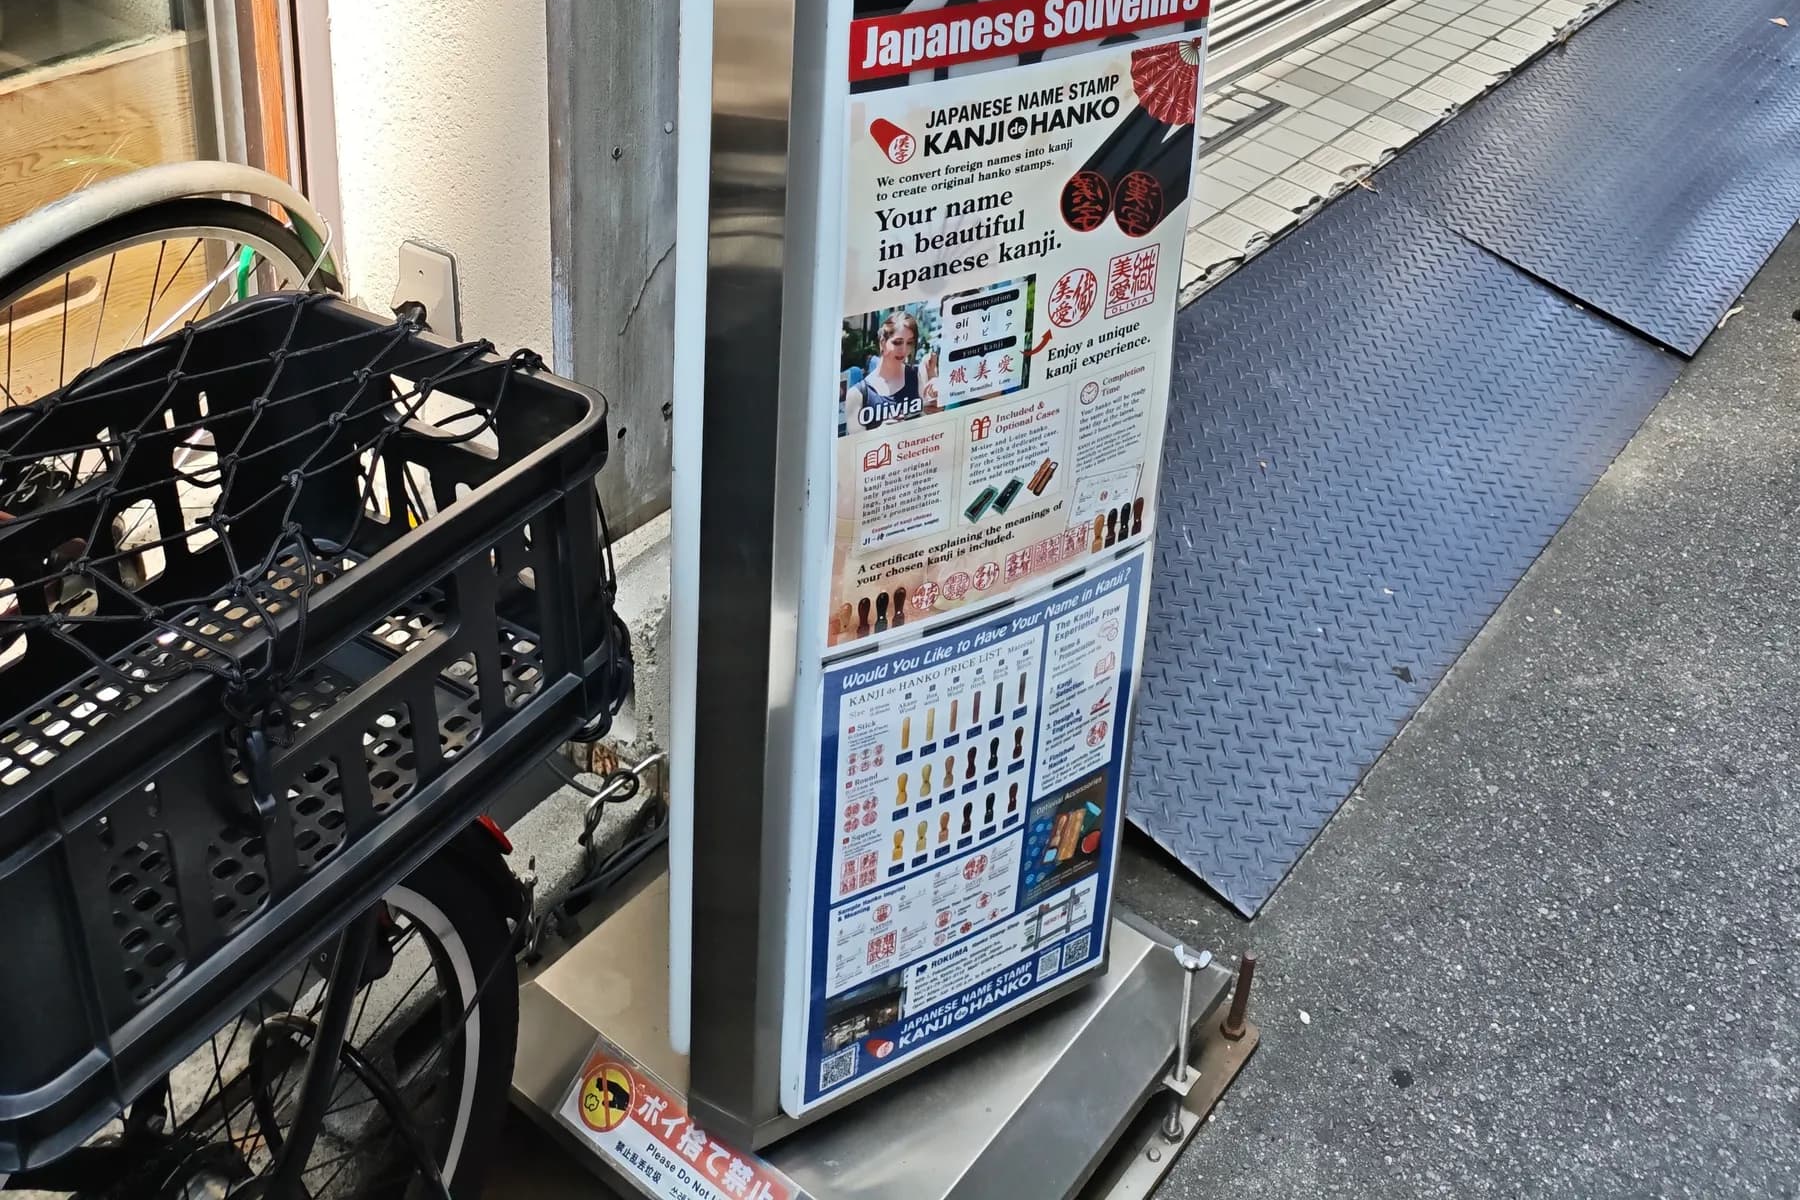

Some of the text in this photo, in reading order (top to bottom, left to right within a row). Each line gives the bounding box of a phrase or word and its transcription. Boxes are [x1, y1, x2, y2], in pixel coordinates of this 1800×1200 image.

[862, 9, 1034, 69] Japanese
[926, 75, 1119, 129] JAPANESE NAME STAMP
[923, 96, 1120, 157] KANJI de HANKO
[877, 140, 1073, 188] We convert foreign names into kanji
[877, 160, 1054, 201] to create original hanko stamps.
[875, 191, 1013, 232] Your name
[879, 209, 1025, 261] in beautiful
[872, 231, 1062, 292] Japanese kanji.
[1111, 297, 1148, 314] OLIVIA
[1046, 335, 1150, 379] kanji experience.
[1048, 322, 1140, 361] Enjoy a unique
[1101, 385, 1120, 396] Time
[1103, 366, 1145, 385] Completion
[859, 398, 922, 426] Olivia
[995, 408, 1060, 433] Optional Cases
[997, 401, 1044, 422] Included &
[896, 444, 940, 462] Selection
[897, 432, 944, 450] Character
[864, 467, 937, 492] kanji book featuring
[865, 474, 885, 484] Using
[903, 460, 931, 472] original
[863, 491, 940, 516] kanji that match your
[864, 492, 878, 500] only
[882, 484, 910, 496] positive
[883, 496, 896, 504] you
[914, 483, 938, 493] choose
[858, 501, 1063, 573] A certificate explaining the meanings of
[856, 532, 1014, 587] your chosen kanji is included.
[1055, 605, 1120, 641] Experience Flow
[1056, 608, 1094, 630] The Kanji
[842, 665, 887, 689] Would
[893, 657, 920, 672] You
[923, 646, 952, 664] Like
[957, 640, 970, 651] to
[974, 628, 1006, 646] Have
[1011, 613, 1040, 632] Your
[1044, 597, 1079, 620] Name
[1082, 588, 1091, 600] in
[850, 689, 884, 707] KANJI
[899, 671, 940, 691] HANKO
[944, 659, 977, 676] PRICE
[979, 647, 1002, 663] LIST
[857, 720, 876, 731] Stick
[855, 773, 878, 786] Round
[931, 946, 968, 968] ROKUMA
[899, 1014, 951, 1048] KANJI
[970, 973, 1032, 1014] HANKO
[901, 962, 1032, 1034] JAPANESE NAME STAMP
[615, 1141, 662, 1184] 禁止乱丢垃圾
[646, 1144, 675, 1172] Please
[677, 1168, 690, 1184] Do
[692, 1180, 710, 1198] Not
